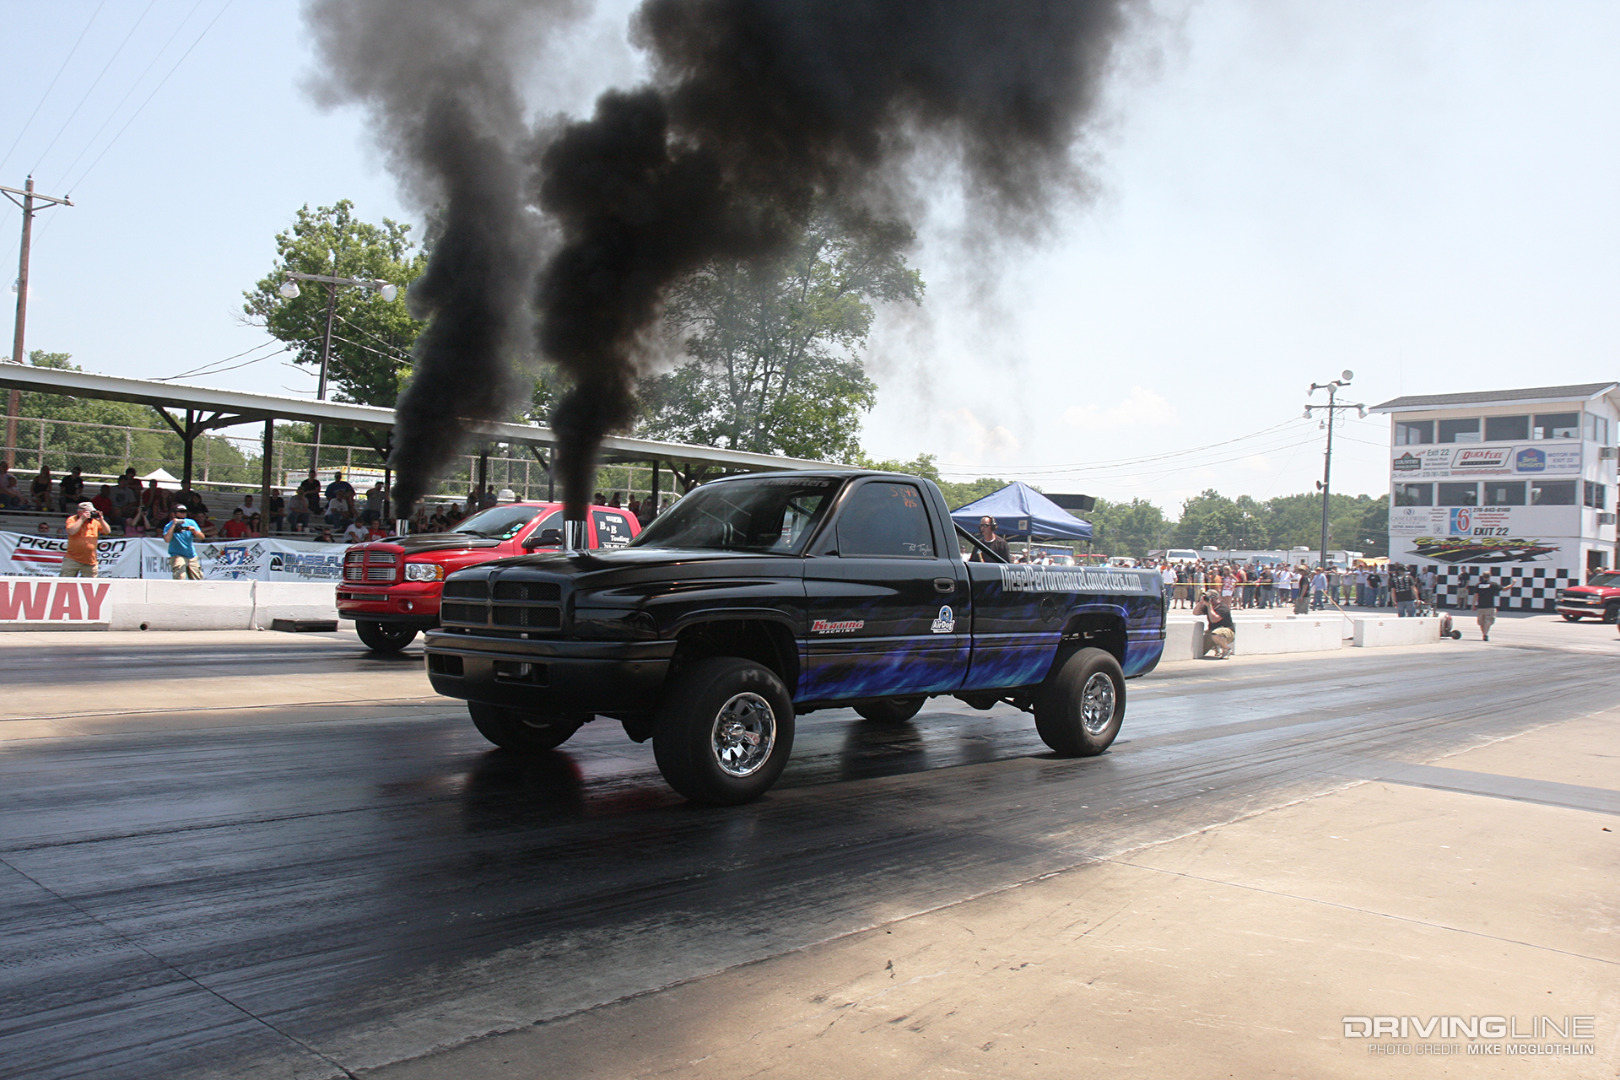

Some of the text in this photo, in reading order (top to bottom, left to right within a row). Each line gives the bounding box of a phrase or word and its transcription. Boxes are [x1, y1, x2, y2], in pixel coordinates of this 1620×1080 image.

[1440, 448, 1449, 456] 22
[1457, 508, 1470, 531] 6
[599, 521, 606, 530] B
[610, 525, 617, 534] B
[1474, 527, 1494, 536] EXIT
[1495, 527, 1509, 536] 22
[145, 556, 158, 573] WE
[999, 565, 1143, 592] DieselPerformanceConverters.com
[811, 619, 865, 631] KEATING
